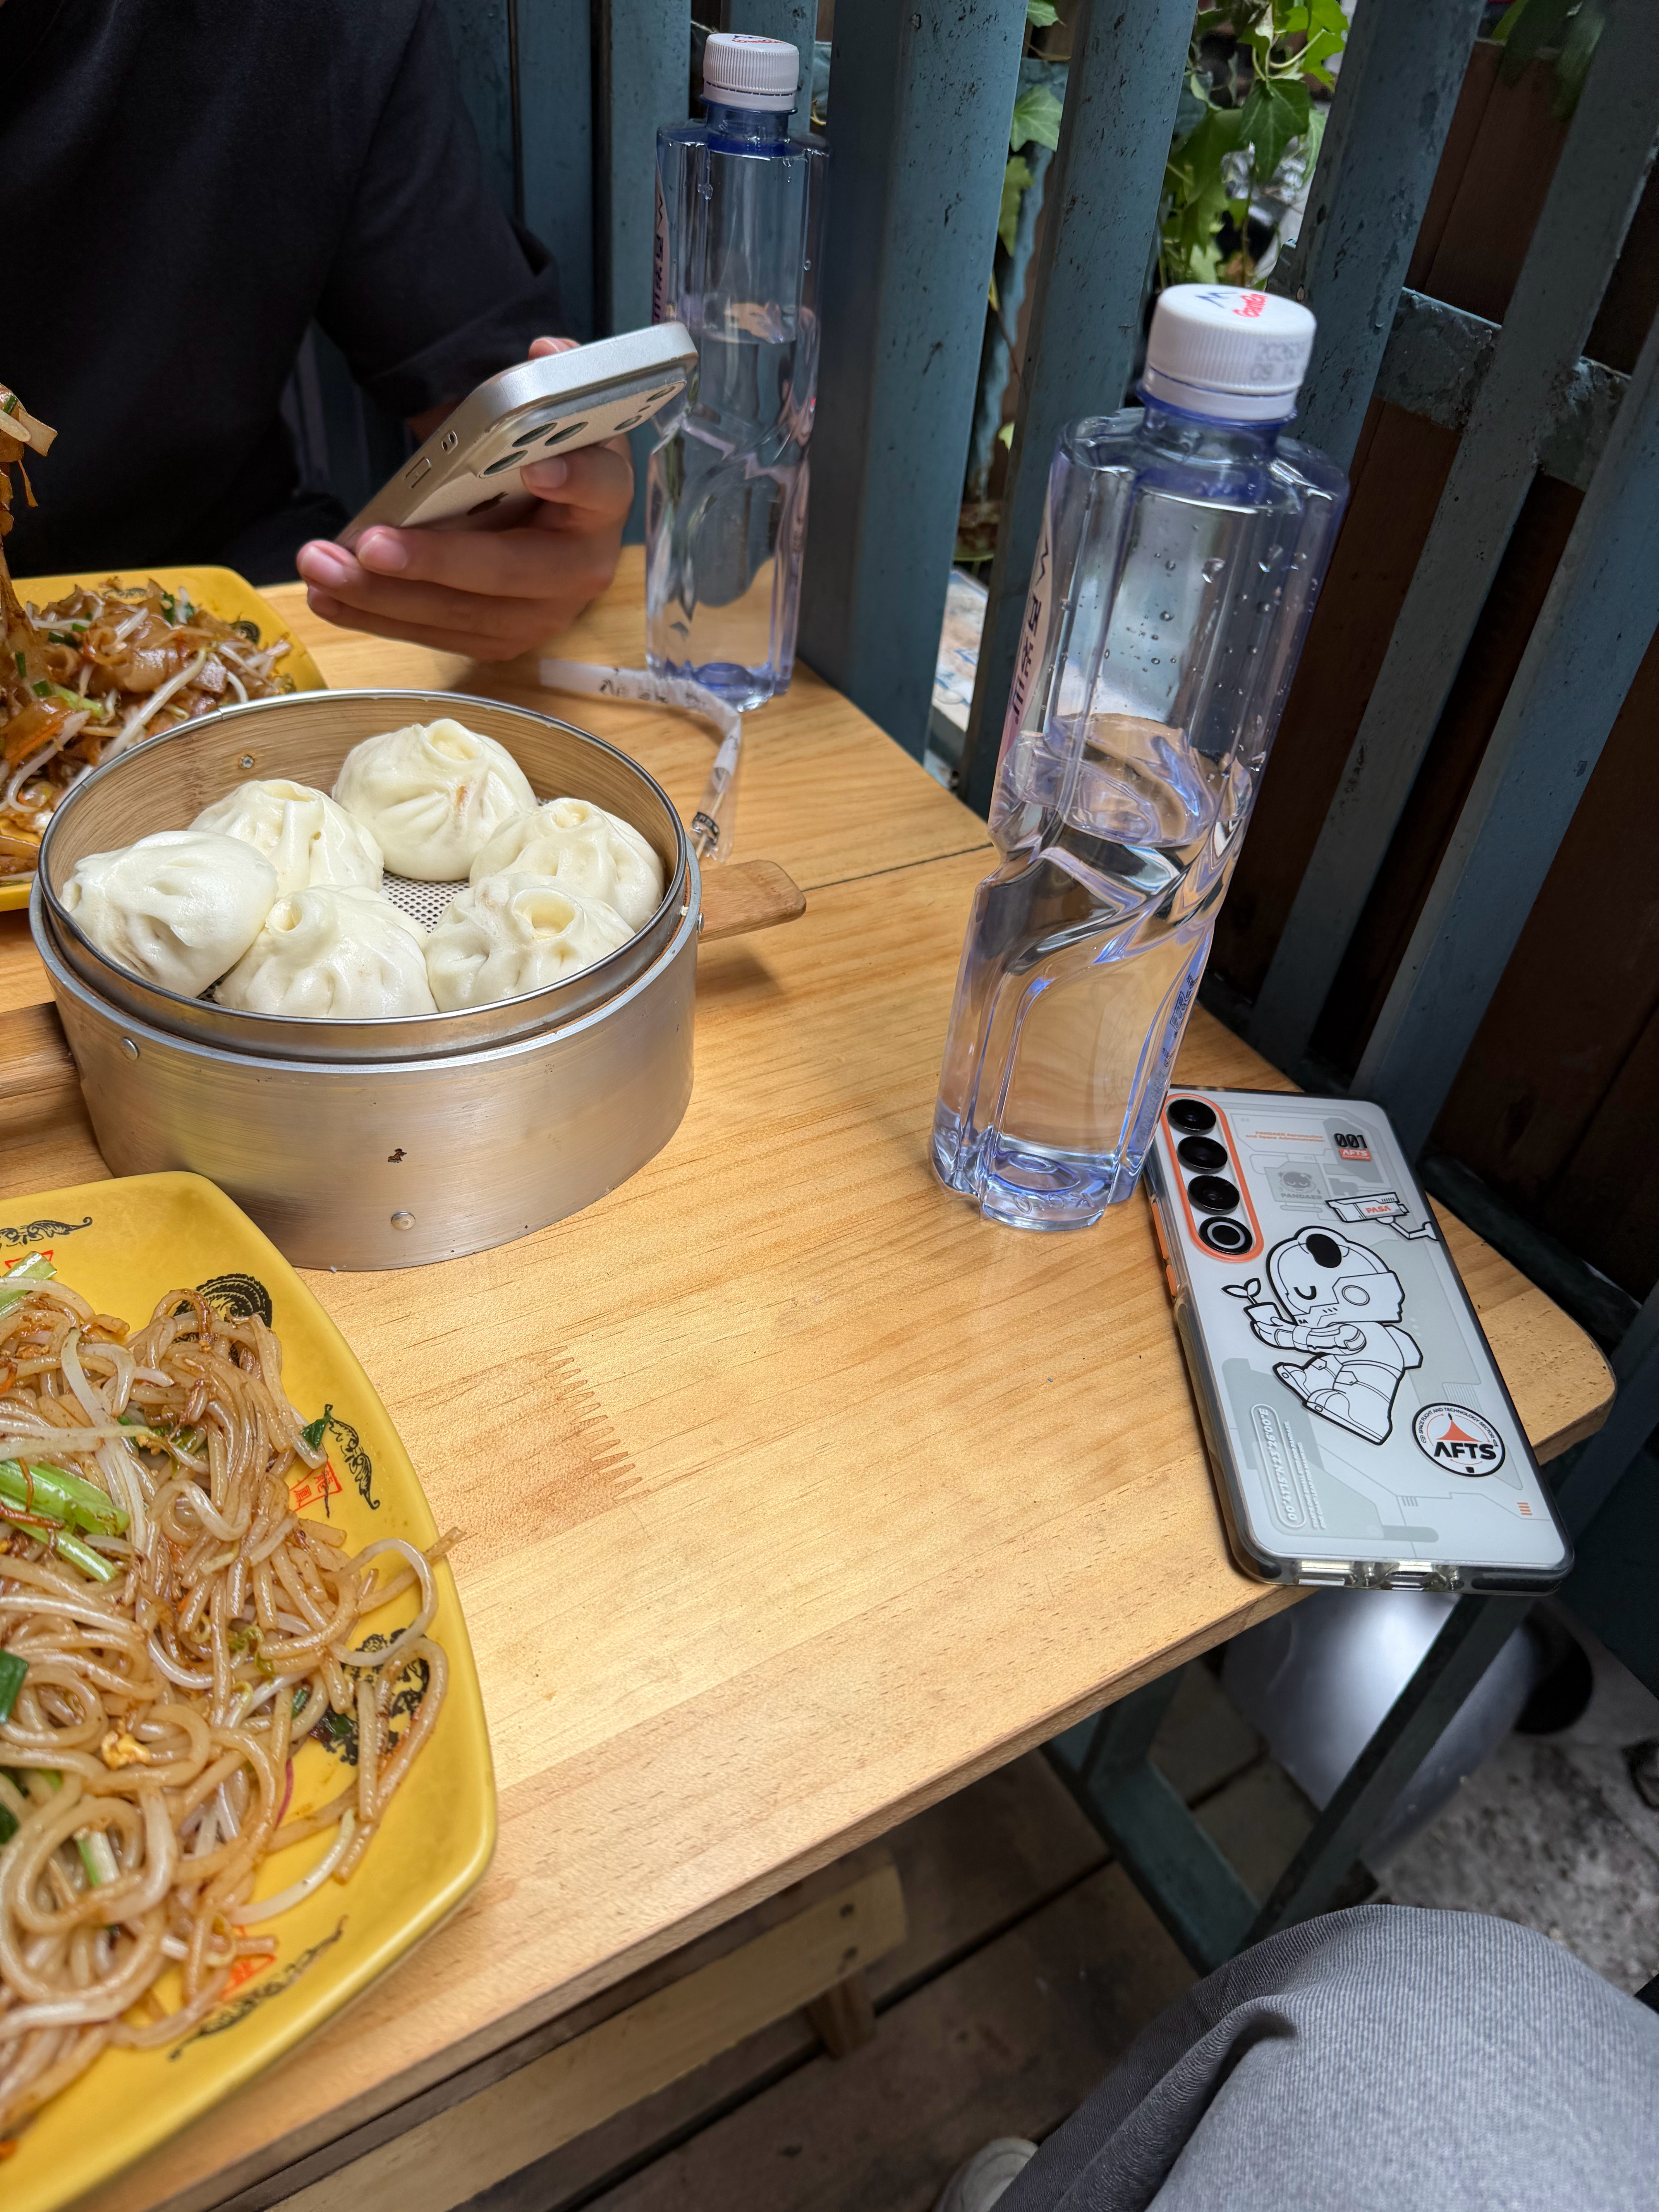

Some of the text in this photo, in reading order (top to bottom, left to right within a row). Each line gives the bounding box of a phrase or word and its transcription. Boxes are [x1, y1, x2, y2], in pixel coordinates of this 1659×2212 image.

[1334, 1133, 1367, 1149] 001
[1365, 1205, 1391, 1214] PASA
[1444, 1407, 1480, 1422] TECHNOLOGY
[1479, 1420, 1495, 1439] SECTOR
[1434, 1441, 1497, 1460] AFTS
